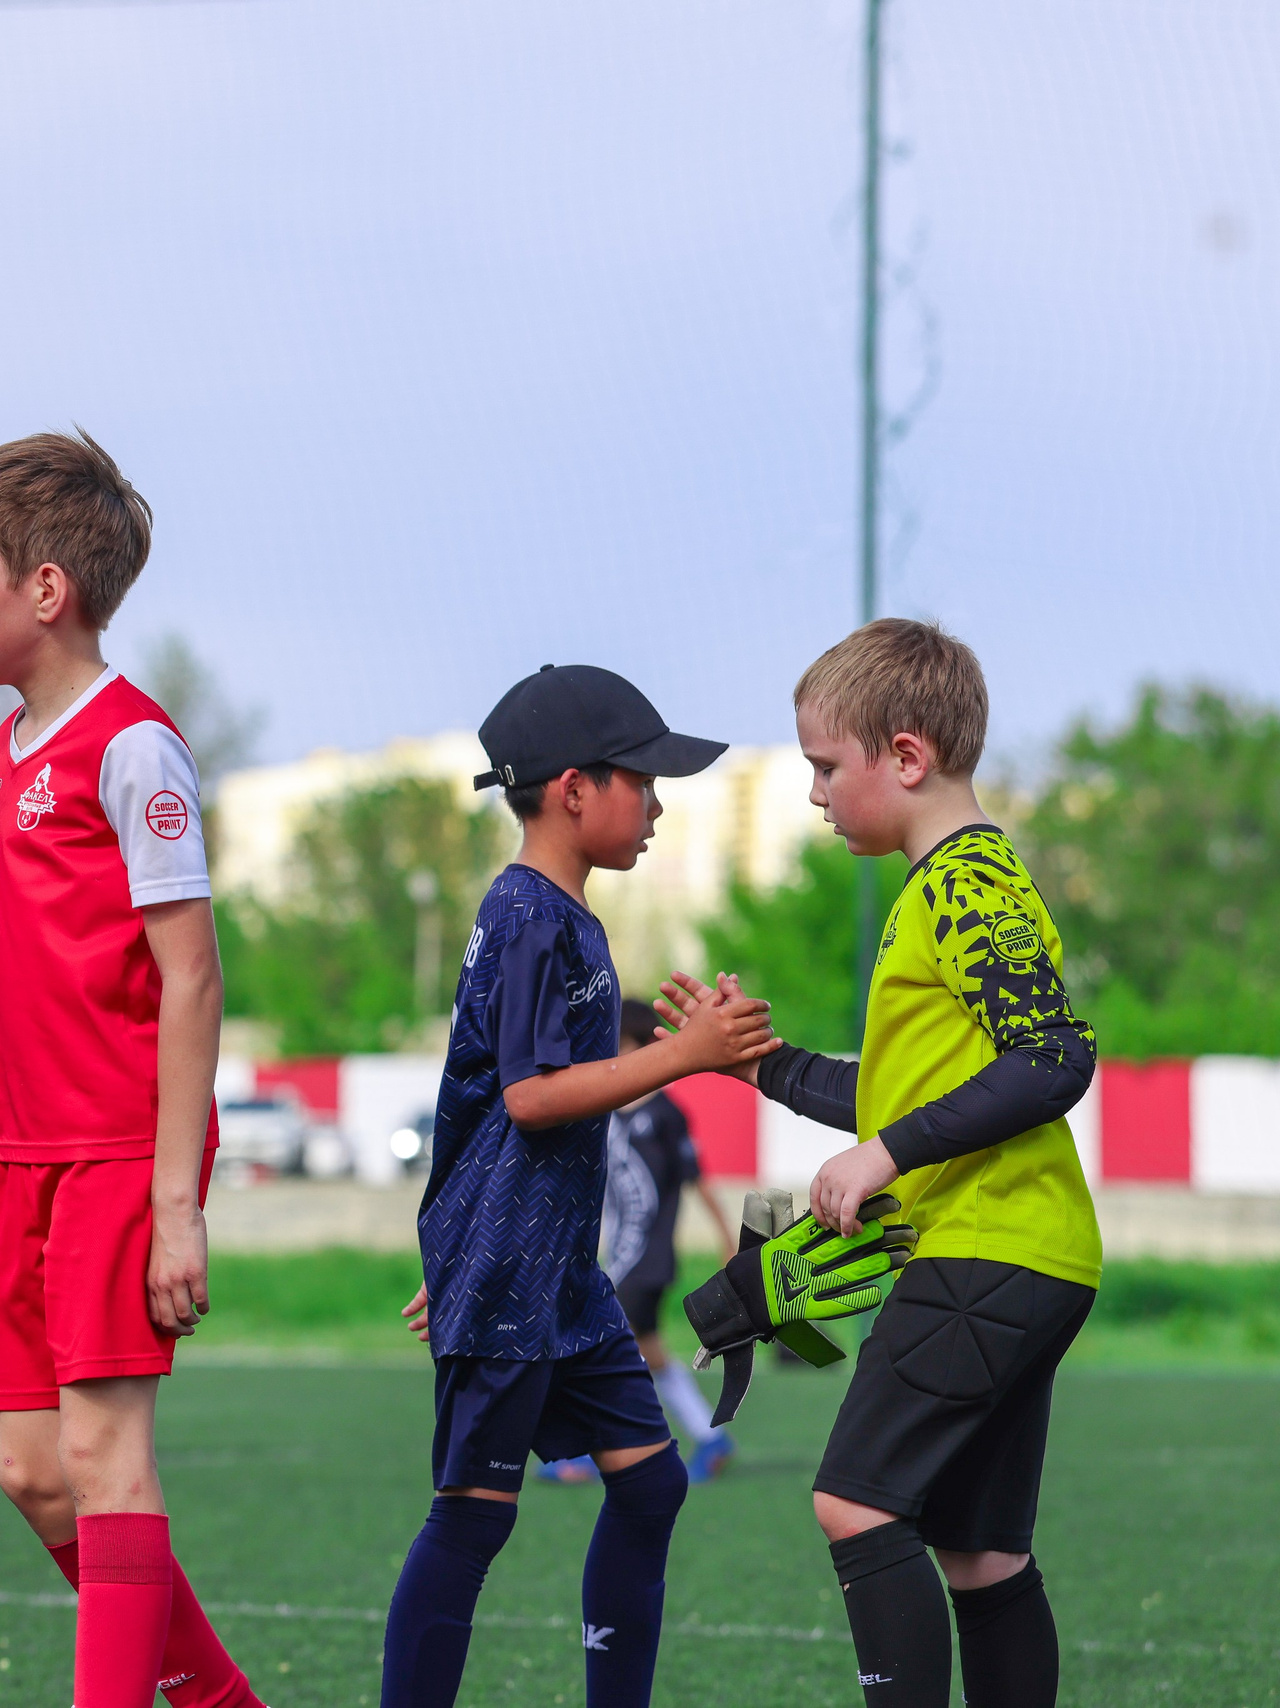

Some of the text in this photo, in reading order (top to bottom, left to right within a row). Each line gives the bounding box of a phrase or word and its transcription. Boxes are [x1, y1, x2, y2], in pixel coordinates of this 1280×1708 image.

[154, 802, 179, 812] SOCCER
[157, 819, 181, 831] PRINT
[998, 925, 1030, 940] SOCCER
[1005, 937, 1036, 953] PRINT
[497, 1323, 518, 1331] DRY+
[501, 1463, 522, 1471] SPORT
